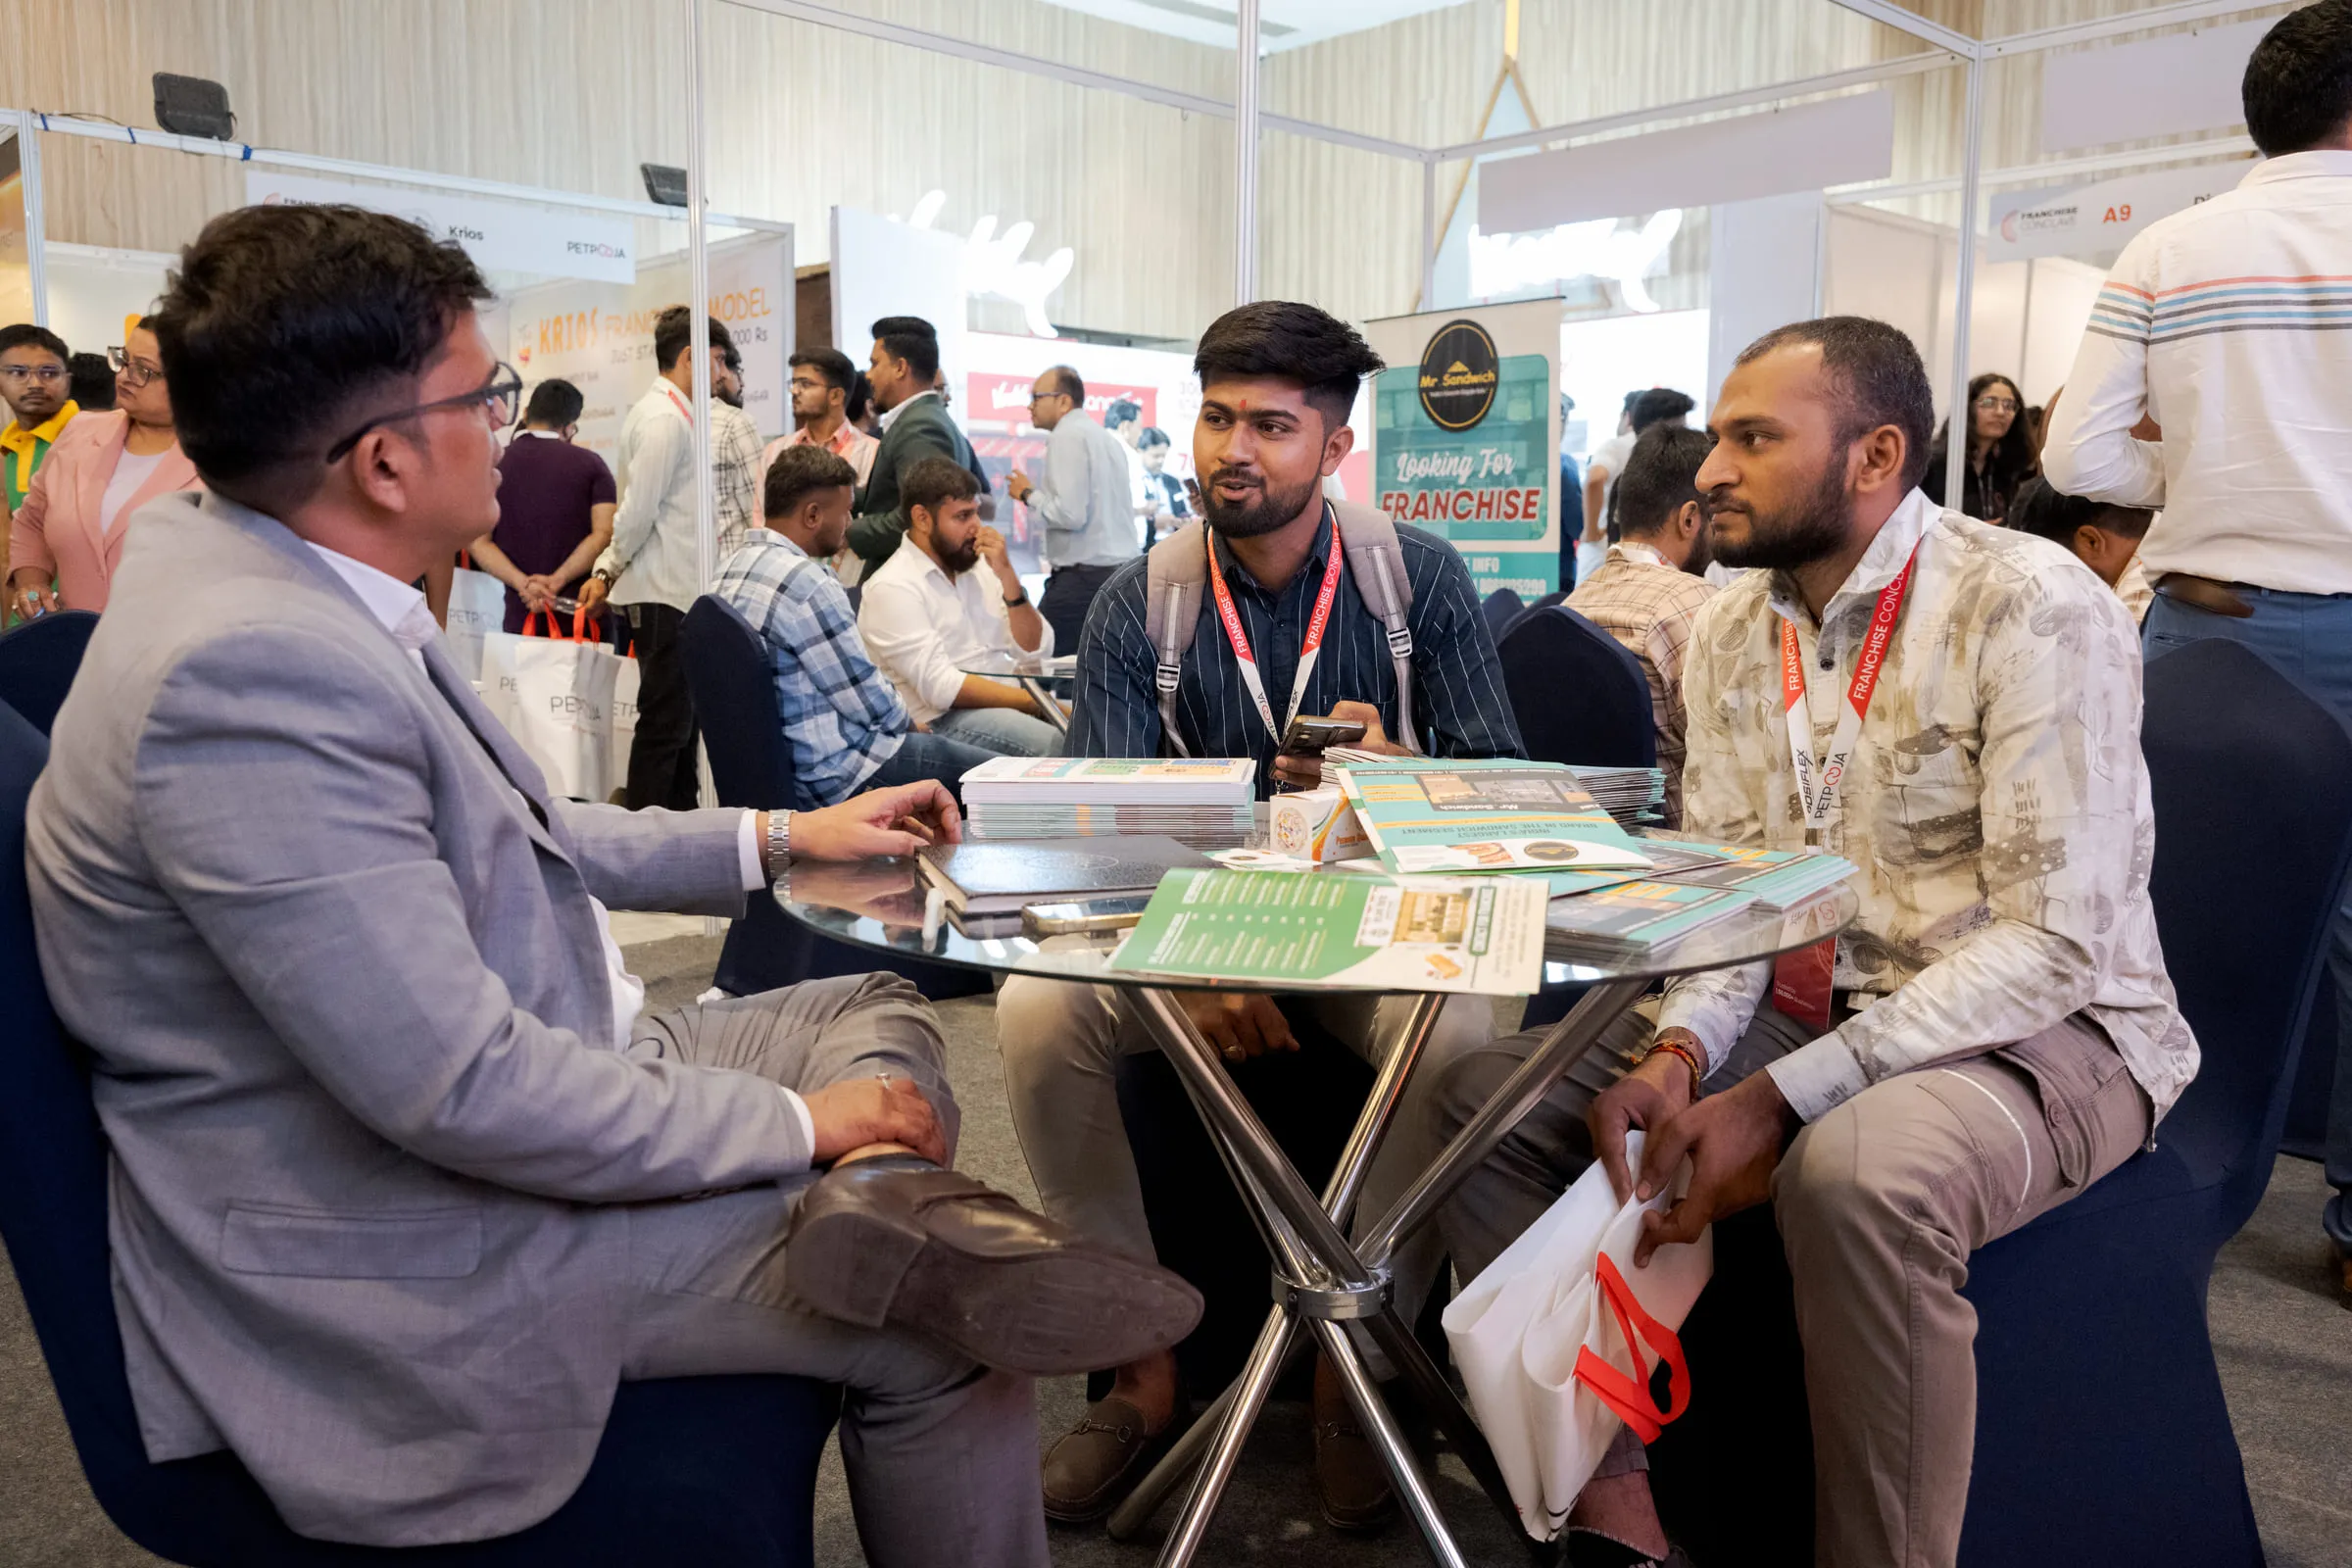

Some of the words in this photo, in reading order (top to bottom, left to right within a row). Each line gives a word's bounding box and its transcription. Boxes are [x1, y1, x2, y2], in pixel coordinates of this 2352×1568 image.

[2021, 206, 2079, 220] FRANCHISE
[2103, 204, 2132, 224] A9
[449, 225, 484, 241] Krios
[566, 240, 626, 260] PETPOOJA
[539, 306, 598, 355] KRIOS
[1420, 375, 1439, 389] Mr
[1443, 370, 1495, 387] Sandwich
[1396, 450, 1474, 485] Looking
[1479, 447, 1516, 479] For
[1381, 488, 1542, 521] FRANCHISE
[1472, 557, 1499, 573] INFO
[1220, 595, 1248, 654] FRANCHISE
[1307, 585, 1332, 645] FRANCHISE
[1853, 624, 1888, 700] FRANCHISE
[1814, 753, 1848, 819] PETPOOJA
[1456, 823, 1517, 832] SANDWICH
